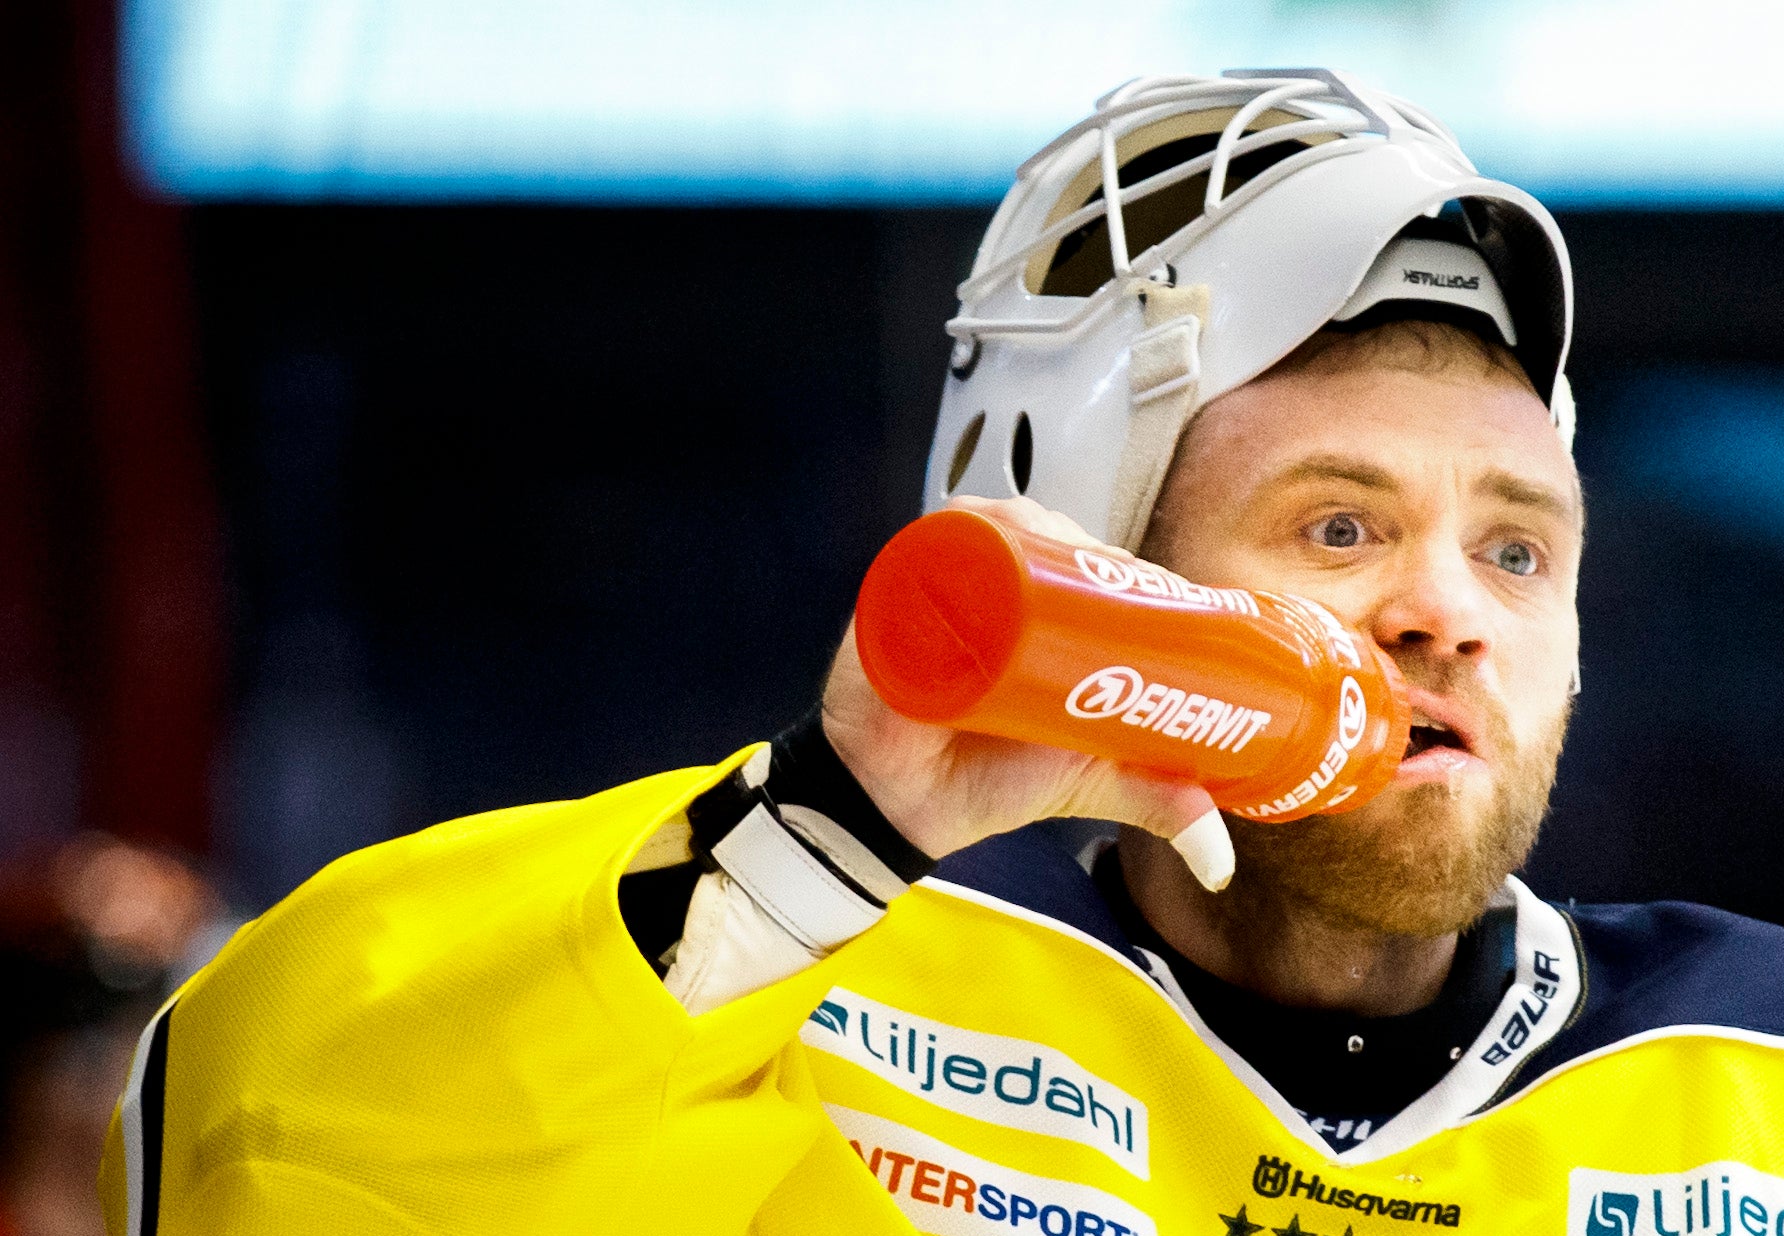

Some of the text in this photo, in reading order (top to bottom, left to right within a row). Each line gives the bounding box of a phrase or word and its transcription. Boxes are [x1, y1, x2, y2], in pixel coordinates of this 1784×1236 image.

[1120, 682, 1272, 753] ENERVIT
[860, 1010, 1134, 1153] Liljedahl
[1289, 1170, 1461, 1228] Husqvarna
